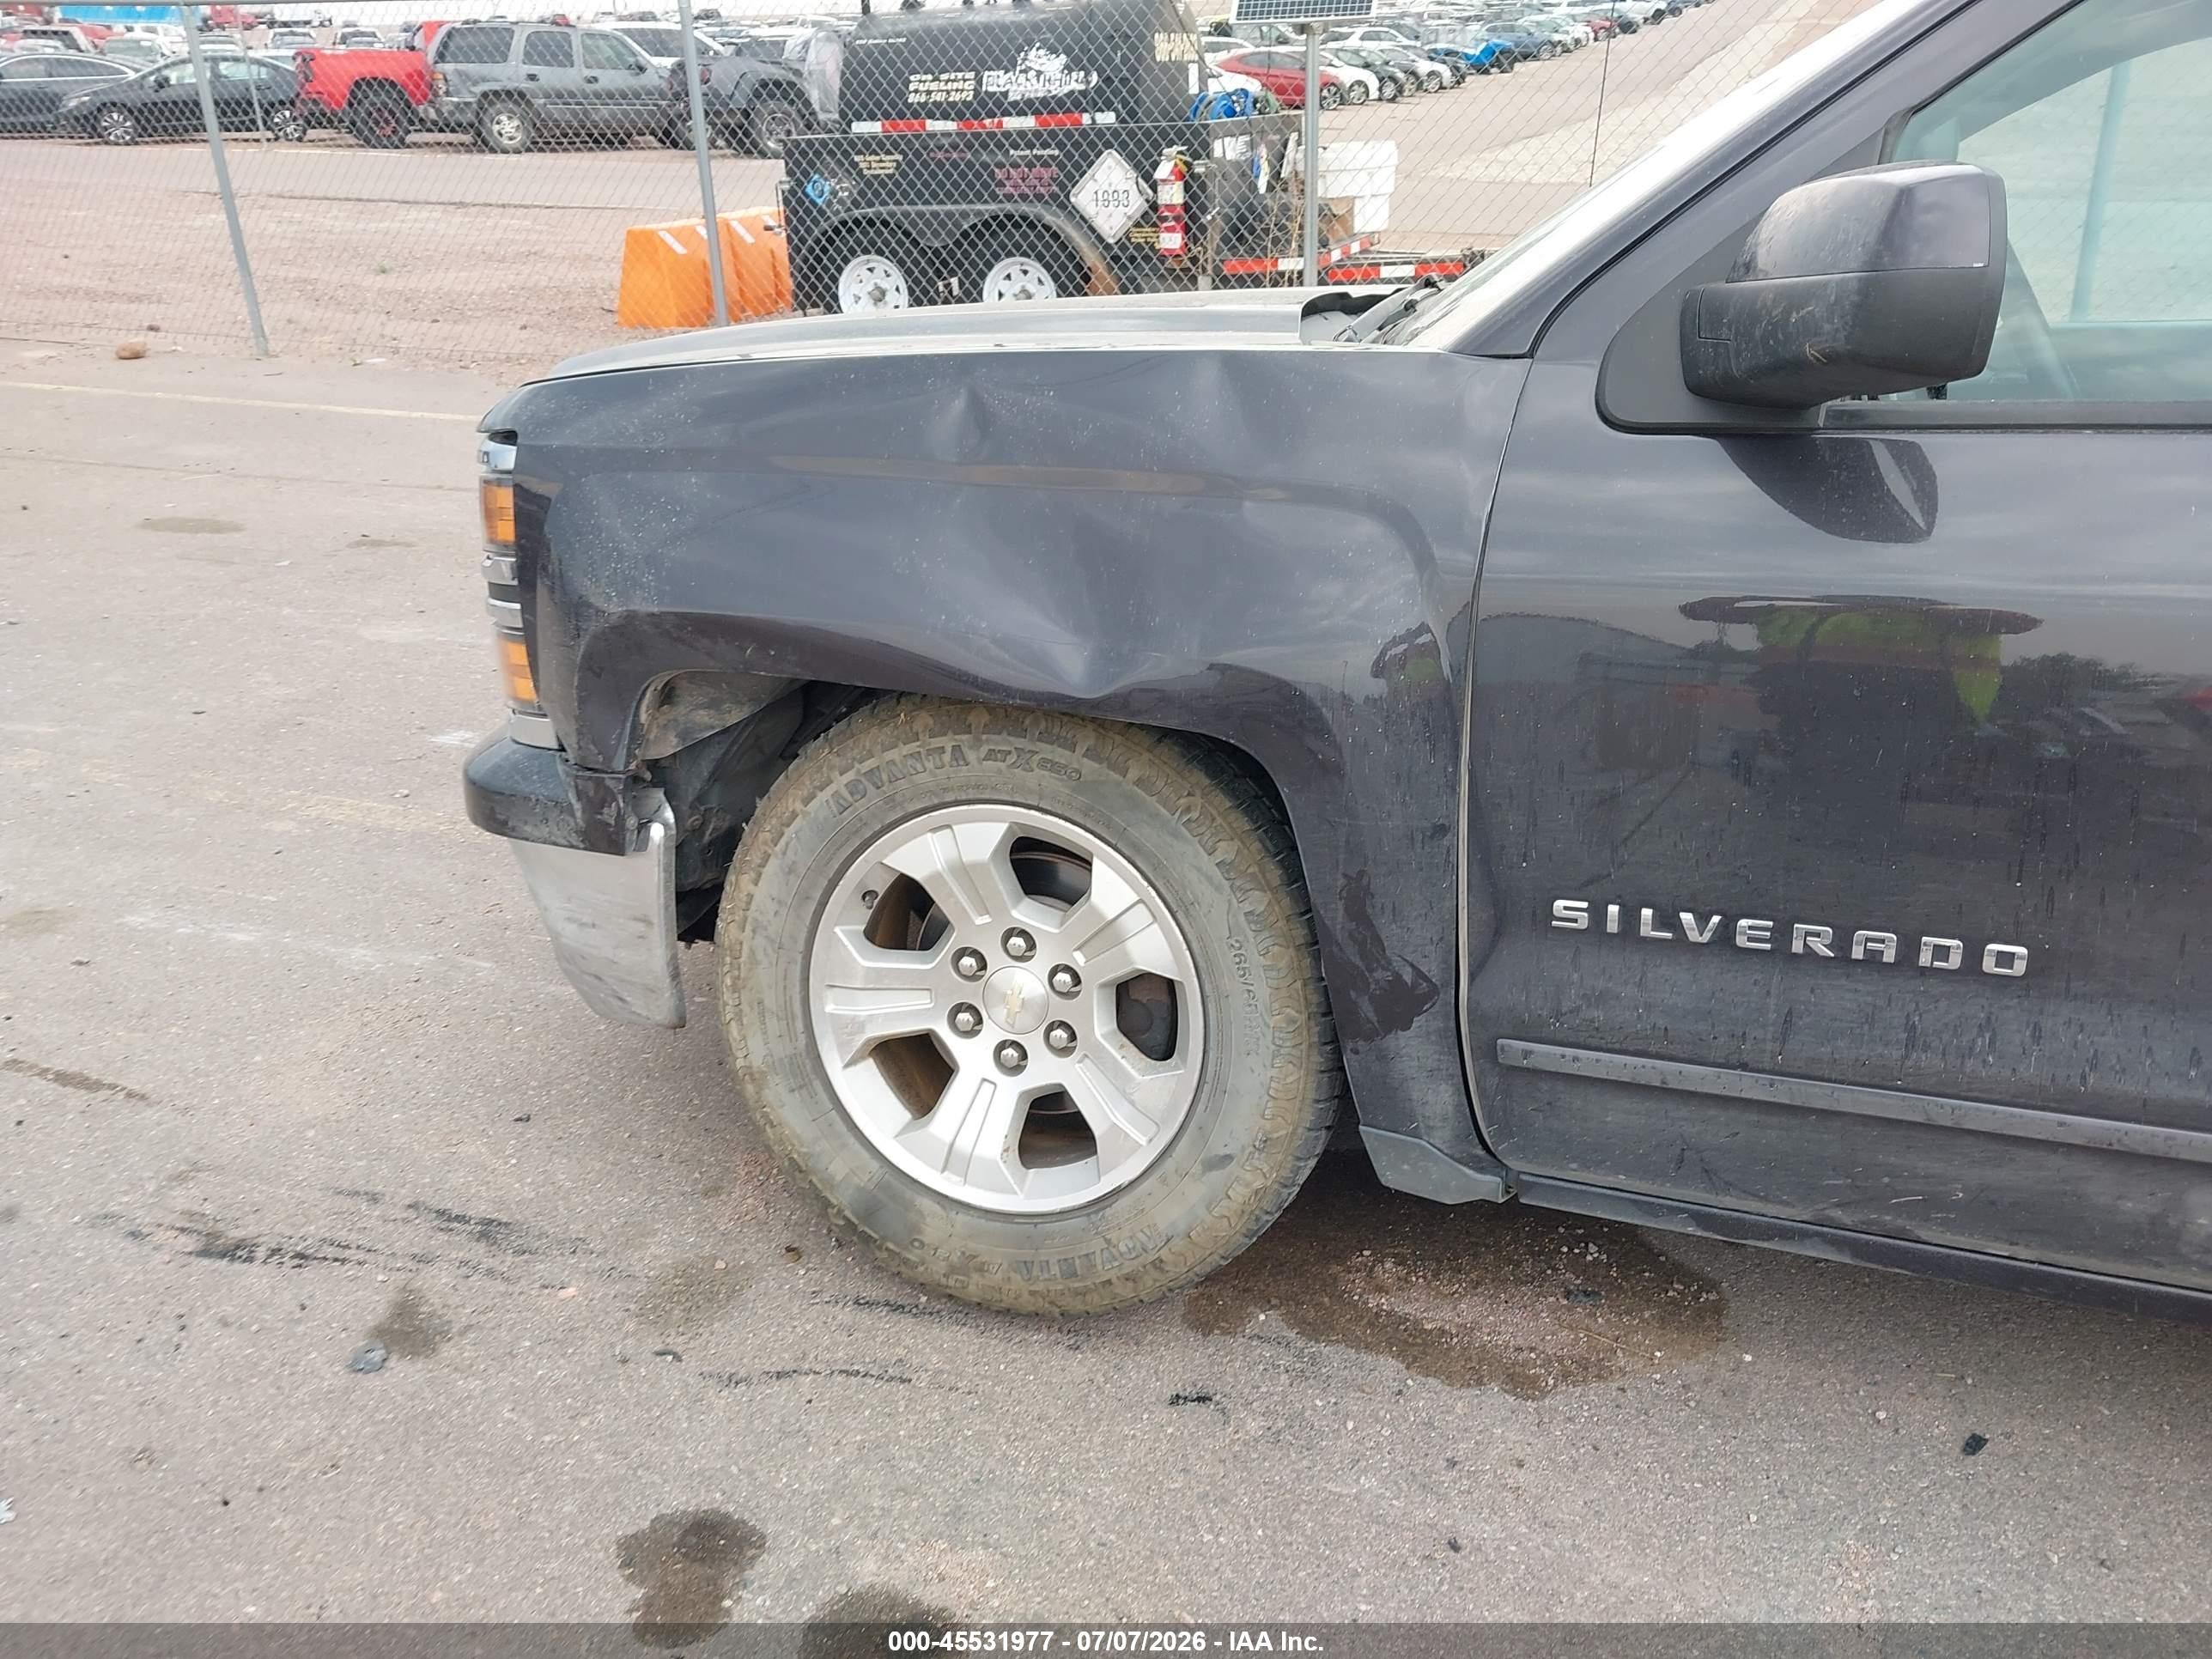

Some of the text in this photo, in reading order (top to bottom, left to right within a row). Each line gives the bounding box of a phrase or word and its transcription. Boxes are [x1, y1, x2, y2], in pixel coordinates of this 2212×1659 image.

[939, 70, 975, 81] SITE
[908, 80, 975, 92] FUELING
[1092, 189, 1130, 208] 1993
[824, 744, 969, 818] ADVANTA
[1551, 899, 2029, 977] SILVERADO
